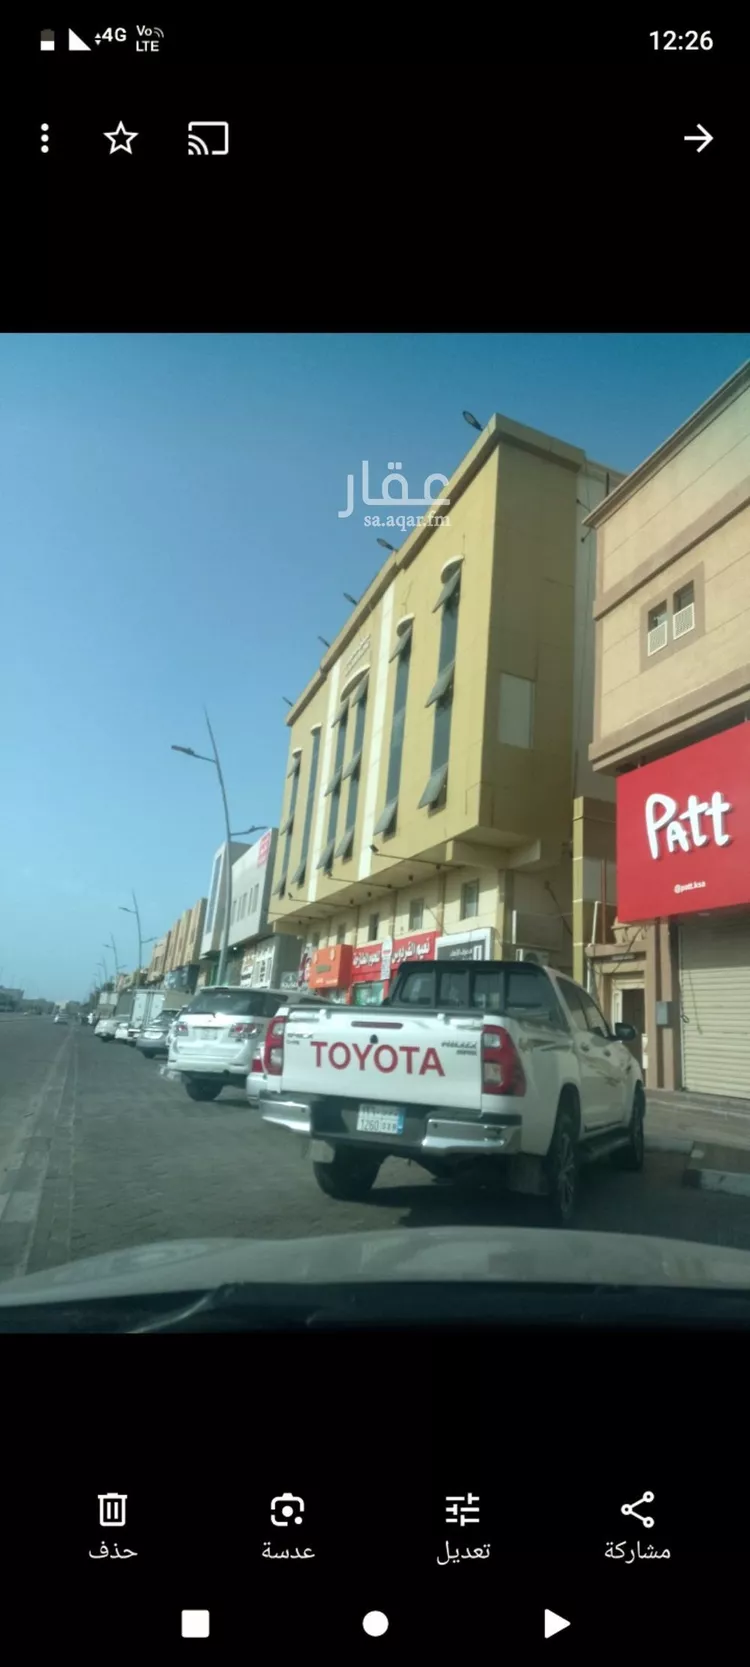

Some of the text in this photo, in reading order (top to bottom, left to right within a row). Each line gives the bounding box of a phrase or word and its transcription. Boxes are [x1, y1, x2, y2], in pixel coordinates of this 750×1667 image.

[102, 26, 127, 43] 4G
[650, 31, 713, 50] 12:26
[136, 40, 160, 52] LTE
[311, 1042, 445, 1076] TOYOTA
[361, 1119, 380, 1131] 1260
[89, 1541, 137, 1558] حذف
[262, 1542, 315, 1558] عدسة
[437, 1541, 490, 1565] تعديل
[605, 1541, 670, 1564] مشاركة
